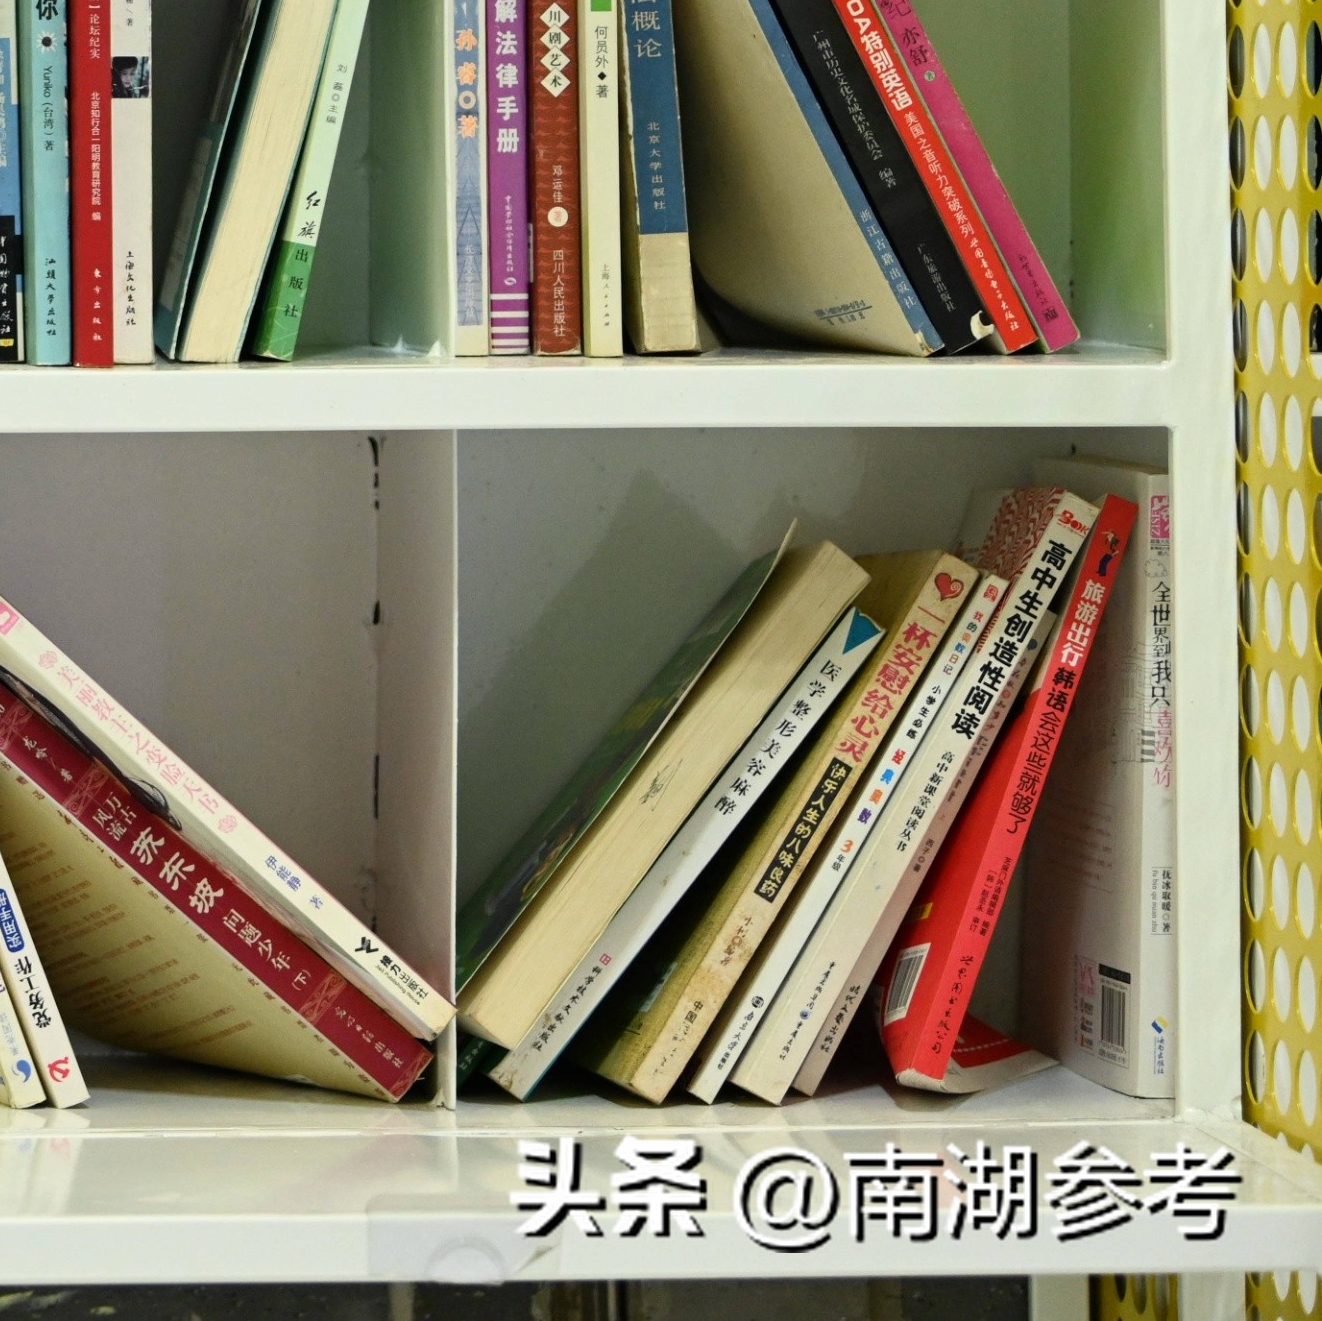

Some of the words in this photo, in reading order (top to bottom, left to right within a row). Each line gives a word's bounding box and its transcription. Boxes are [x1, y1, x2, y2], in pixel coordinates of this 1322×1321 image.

[904, 111, 975, 237] 美国之音听力突破系列
[553, 249, 566, 337] 四川人民出版社
[951, 539, 1073, 741] 高中生创造性阅读
[1060, 578, 1106, 668] 旅游出行
[835, 606, 947, 764] 一杯安慰给心灵
[1047, 666, 1076, 713] 韩语
[714, 658, 839, 816] 医学整形美容麻醉
[130, 826, 224, 915] 苏东坡
[223, 908, 292, 974] 问题少年
[14, 955, 52, 1029] 党务工作
